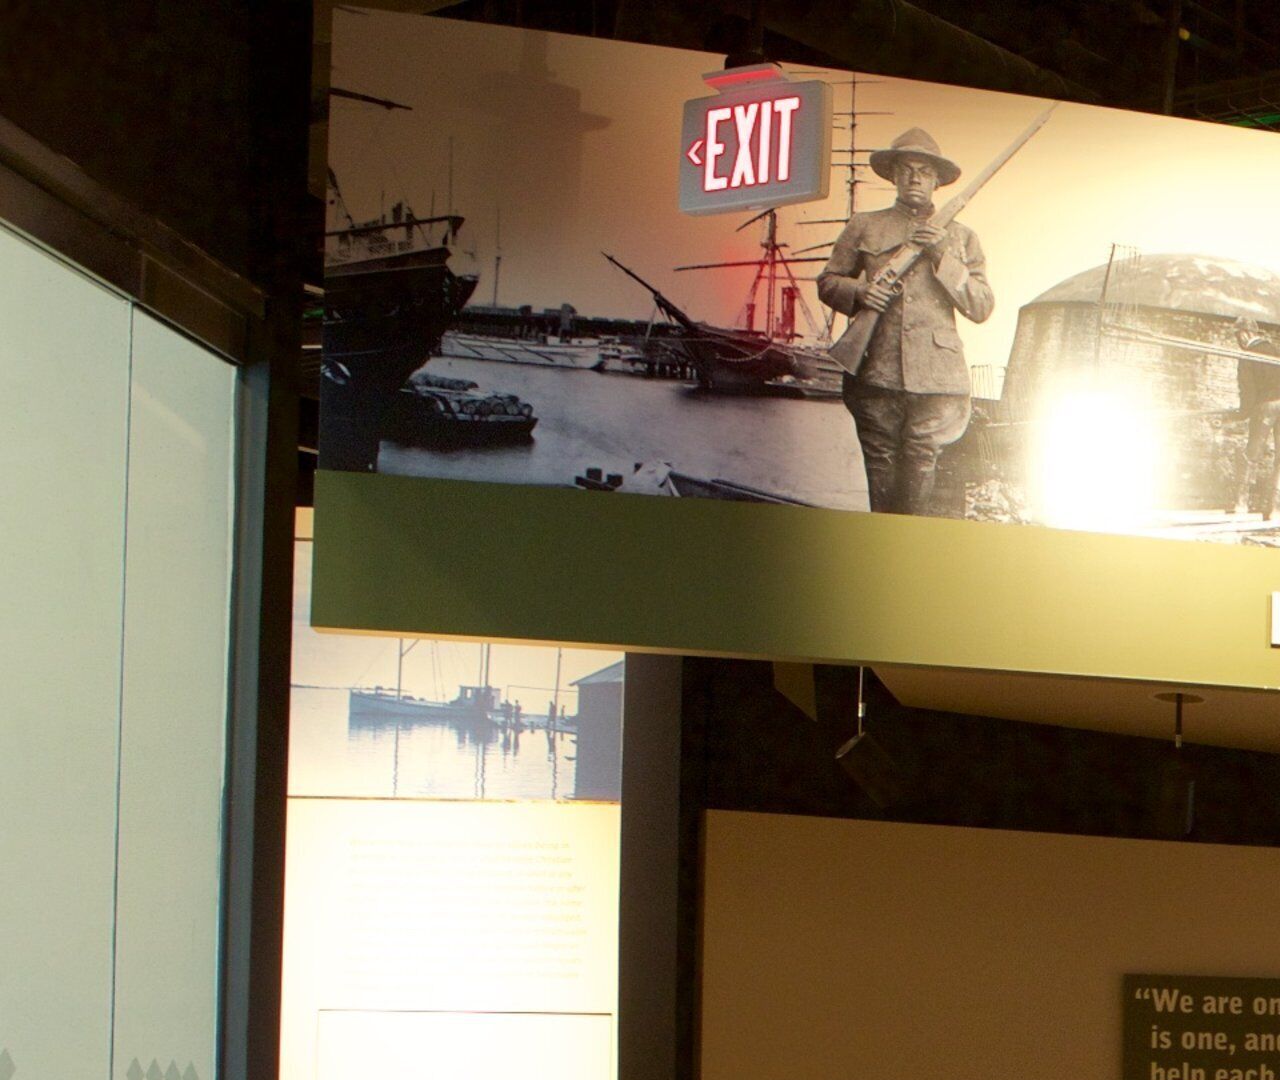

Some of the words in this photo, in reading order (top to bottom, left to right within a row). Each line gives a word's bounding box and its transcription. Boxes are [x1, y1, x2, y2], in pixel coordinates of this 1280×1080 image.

[704, 96, 800, 192] EXIT
[1134, 988, 1194, 1015] “We
[1202, 994, 1243, 1016] are
[1150, 1025, 1172, 1050] is
[1181, 1029, 1236, 1055] one,
